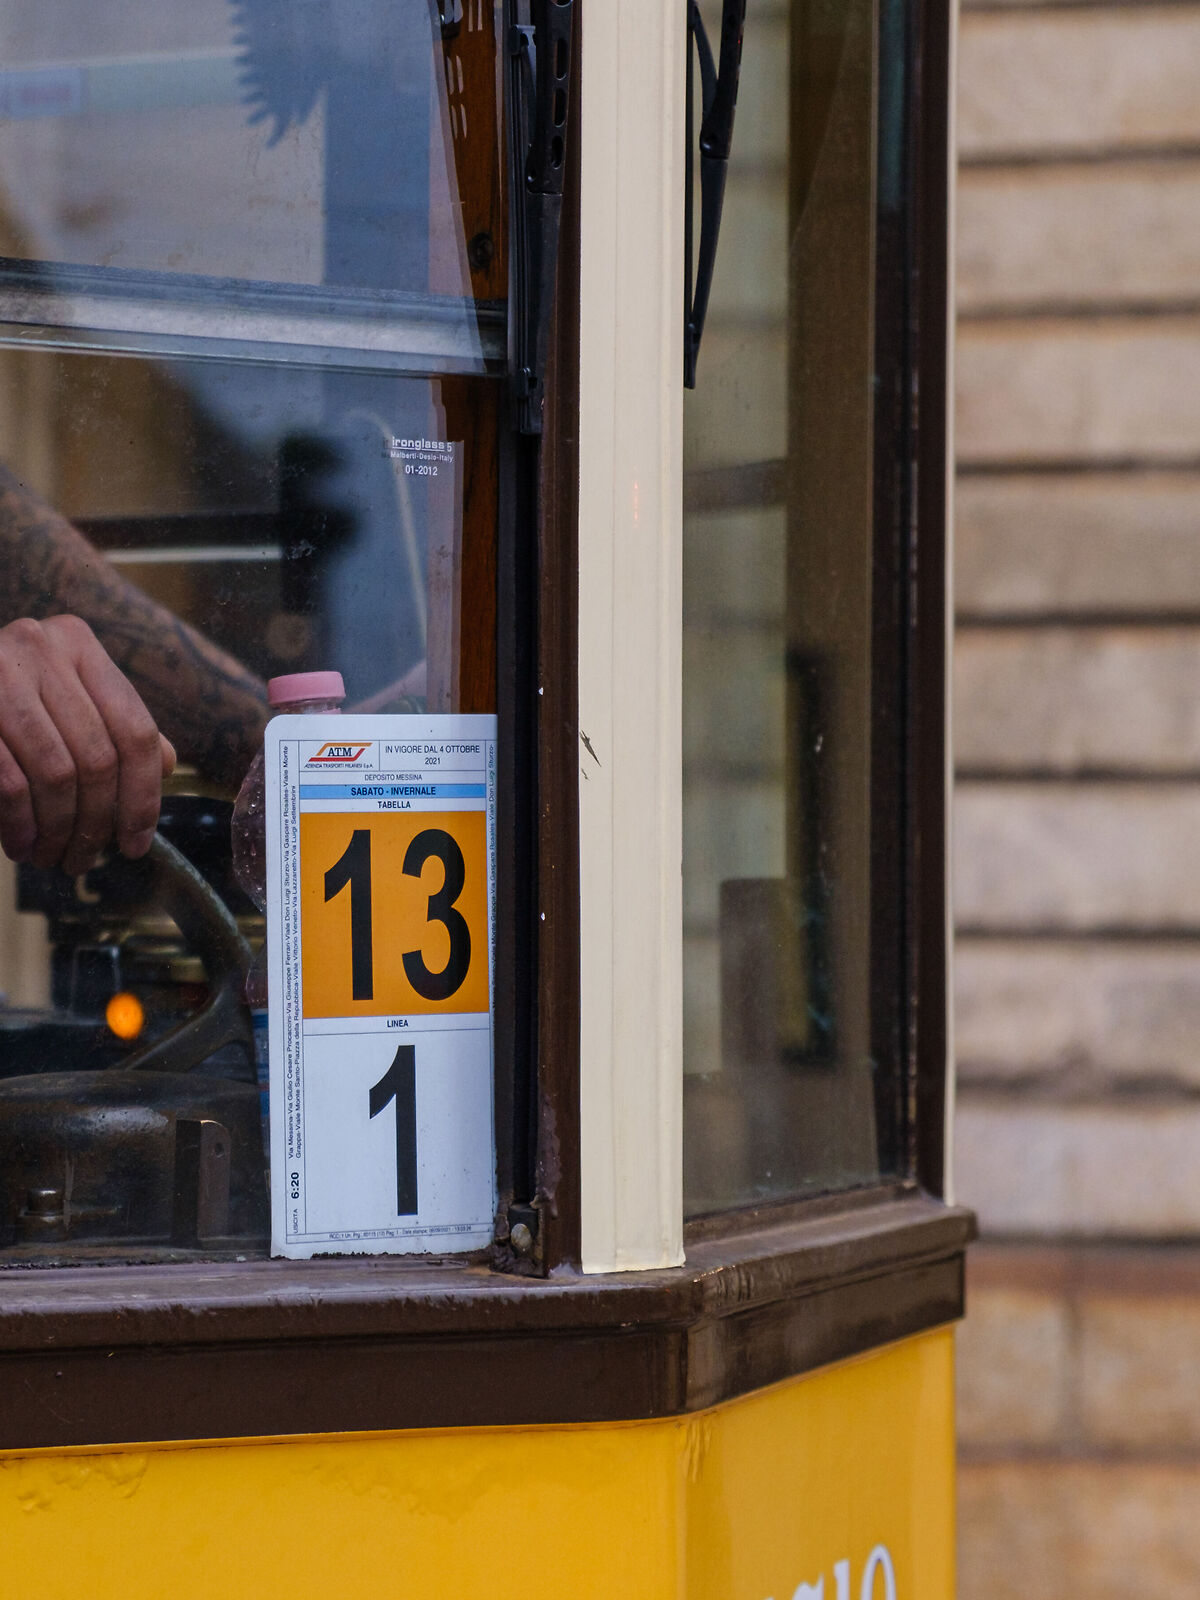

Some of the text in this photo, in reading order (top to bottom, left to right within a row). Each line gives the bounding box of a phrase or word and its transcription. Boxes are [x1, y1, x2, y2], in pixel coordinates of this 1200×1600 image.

[392, 436, 453, 452] ironglass 5
[405, 464, 438, 476] 01-2012
[327, 747, 353, 757] ATM
[385, 745, 480, 753] IN VIGORE DAL 4 OTTOBRE
[424, 757, 441, 765] 2021
[351, 787, 384, 796] SABATO
[390, 786, 436, 795] INVERNALE
[377, 800, 411, 809] TABELLA
[323, 828, 472, 1002] 13
[386, 1019, 409, 1029] LINEA
[368, 1044, 419, 1217] 1
[291, 1172, 300, 1199] 6:20
